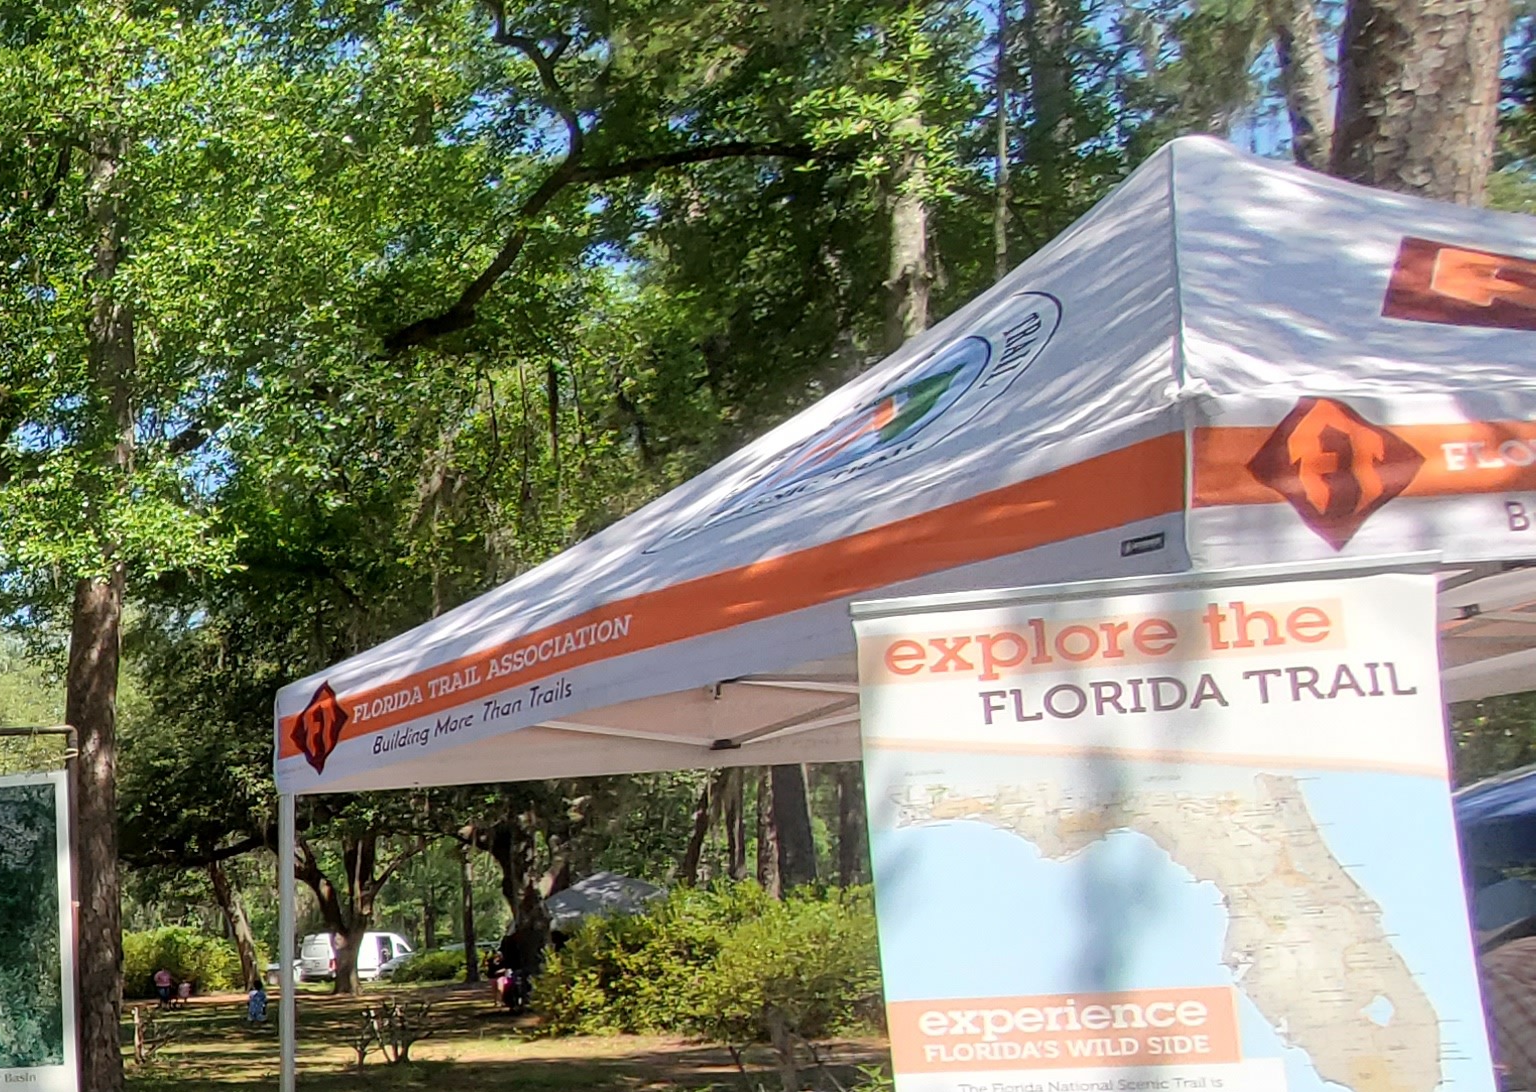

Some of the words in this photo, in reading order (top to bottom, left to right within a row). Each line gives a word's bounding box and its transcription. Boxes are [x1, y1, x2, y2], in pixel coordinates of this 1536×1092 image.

[1440, 439, 1536, 472] FLO
[884, 616, 1178, 681] explore
[1203, 602, 1331, 651] the
[351, 686, 424, 724] FLORIDA
[427, 666, 481, 699] TRAIL
[485, 614, 633, 681] ASSOCIATION
[979, 673, 1228, 726] FLORIDA
[1243, 661, 1417, 706] TRAIL
[372, 726, 430, 755] Building
[434, 713, 474, 738] More
[483, 700, 523, 722] Than
[529, 677, 573, 707] Trails
[918, 998, 1209, 1042] experience
[1065, 1037, 1140, 1058] WILD
[1147, 1034, 1211, 1054] SIDE
[4, 1072, 37, 1084] Basin
[1048, 1079, 1114, 1092] National
[1117, 1078, 1169, 1091] Scenic
[1173, 1076, 1207, 1090] Trail
[1210, 1077, 1224, 1088] is
